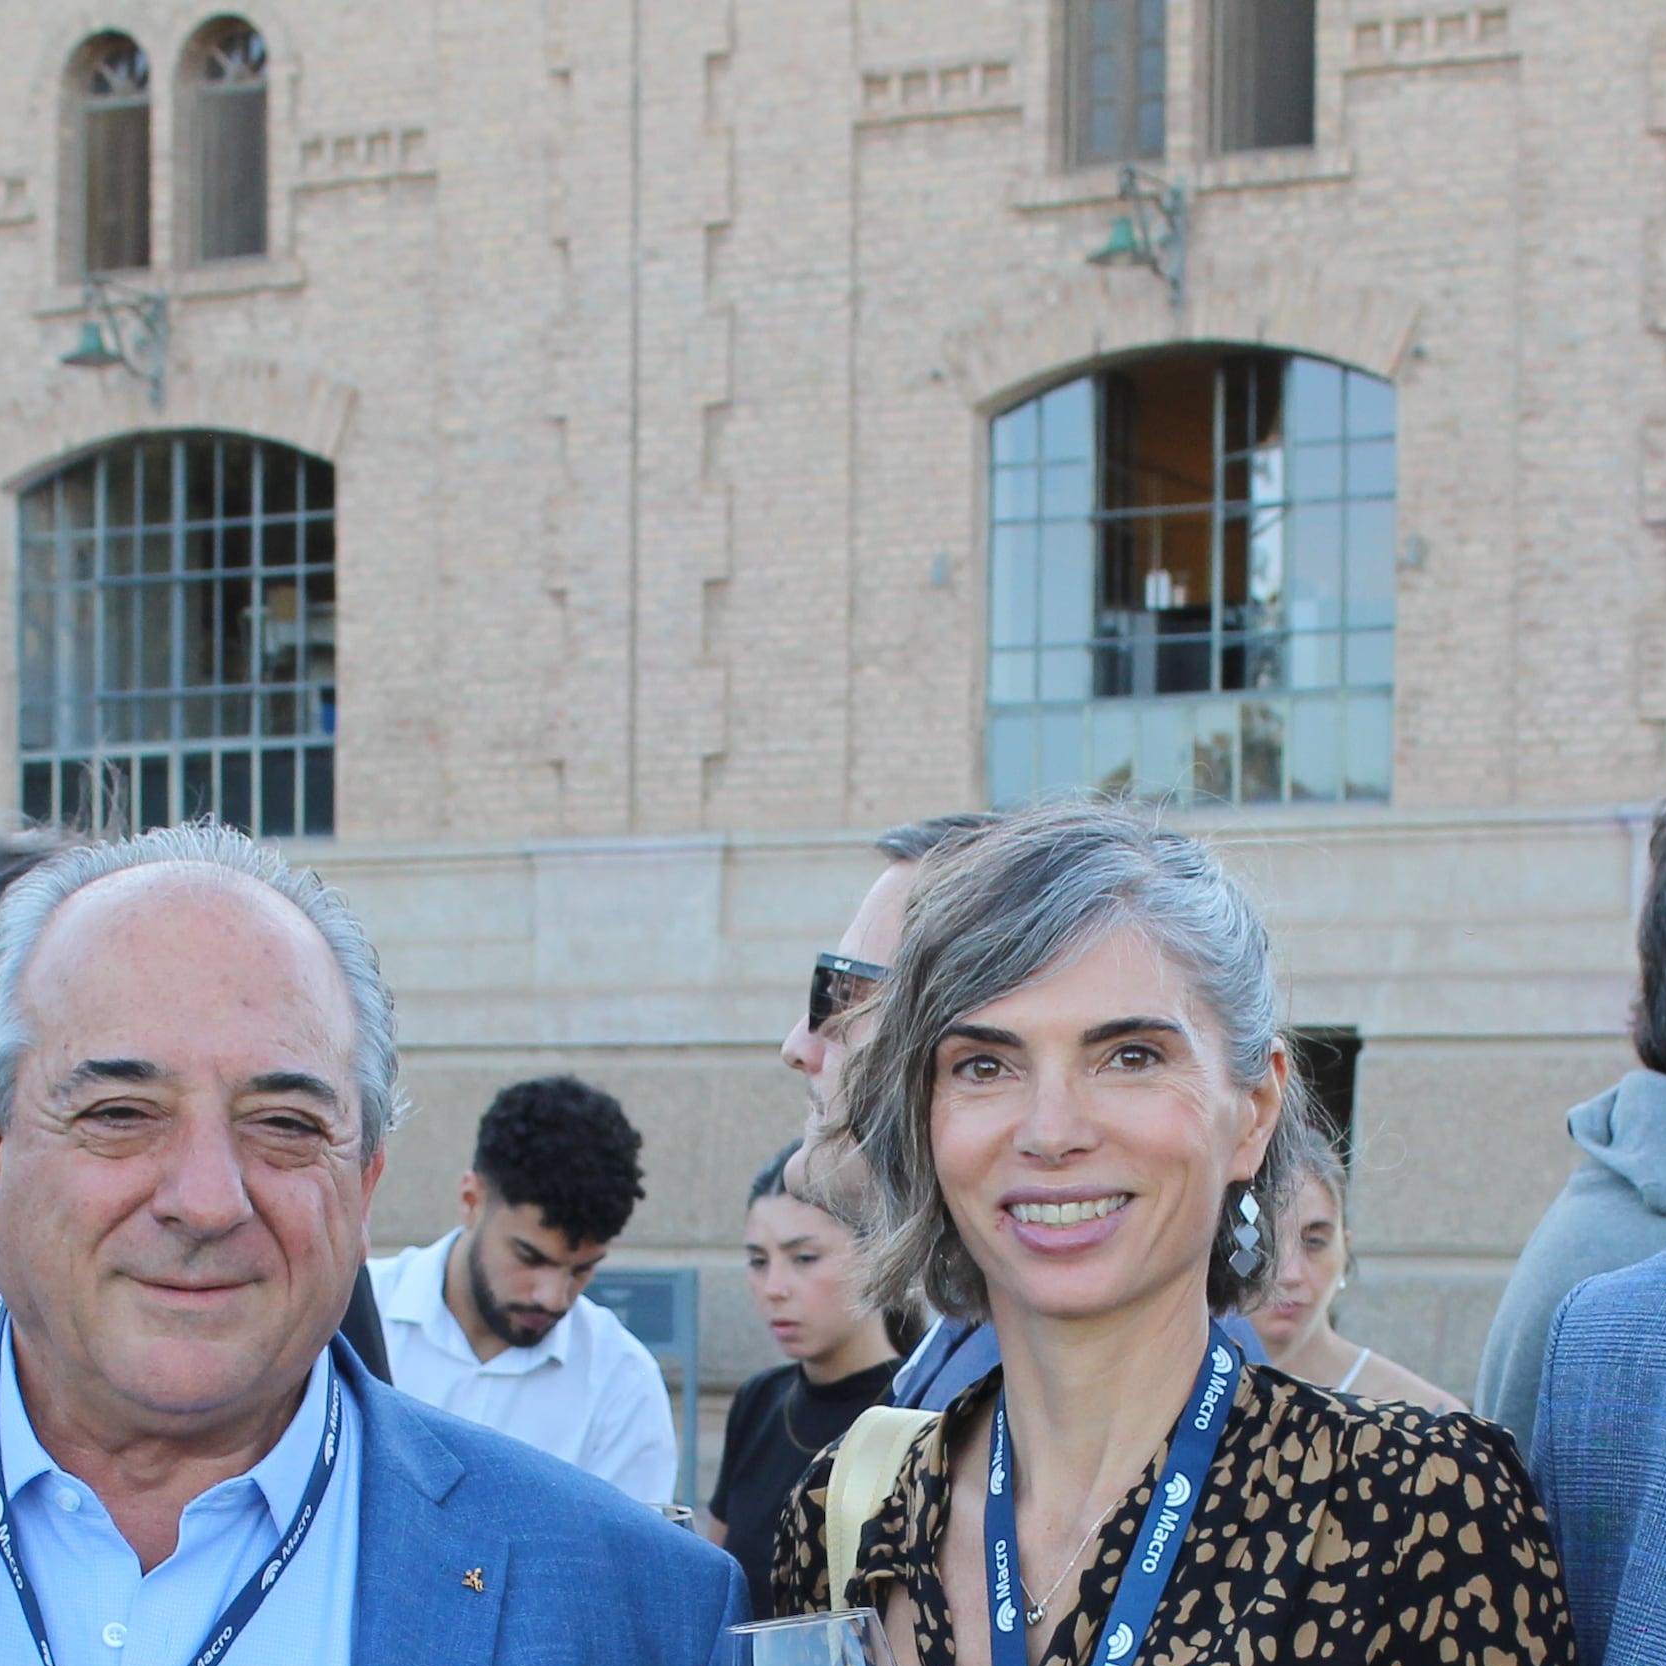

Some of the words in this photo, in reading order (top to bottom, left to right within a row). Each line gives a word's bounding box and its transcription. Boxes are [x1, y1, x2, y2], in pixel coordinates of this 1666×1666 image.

[1194, 1373, 1228, 1431] Macro
[282, 1505, 312, 1560] Macro
[1142, 1508, 1180, 1574] Macro
[995, 1539, 1011, 1600] Macro
